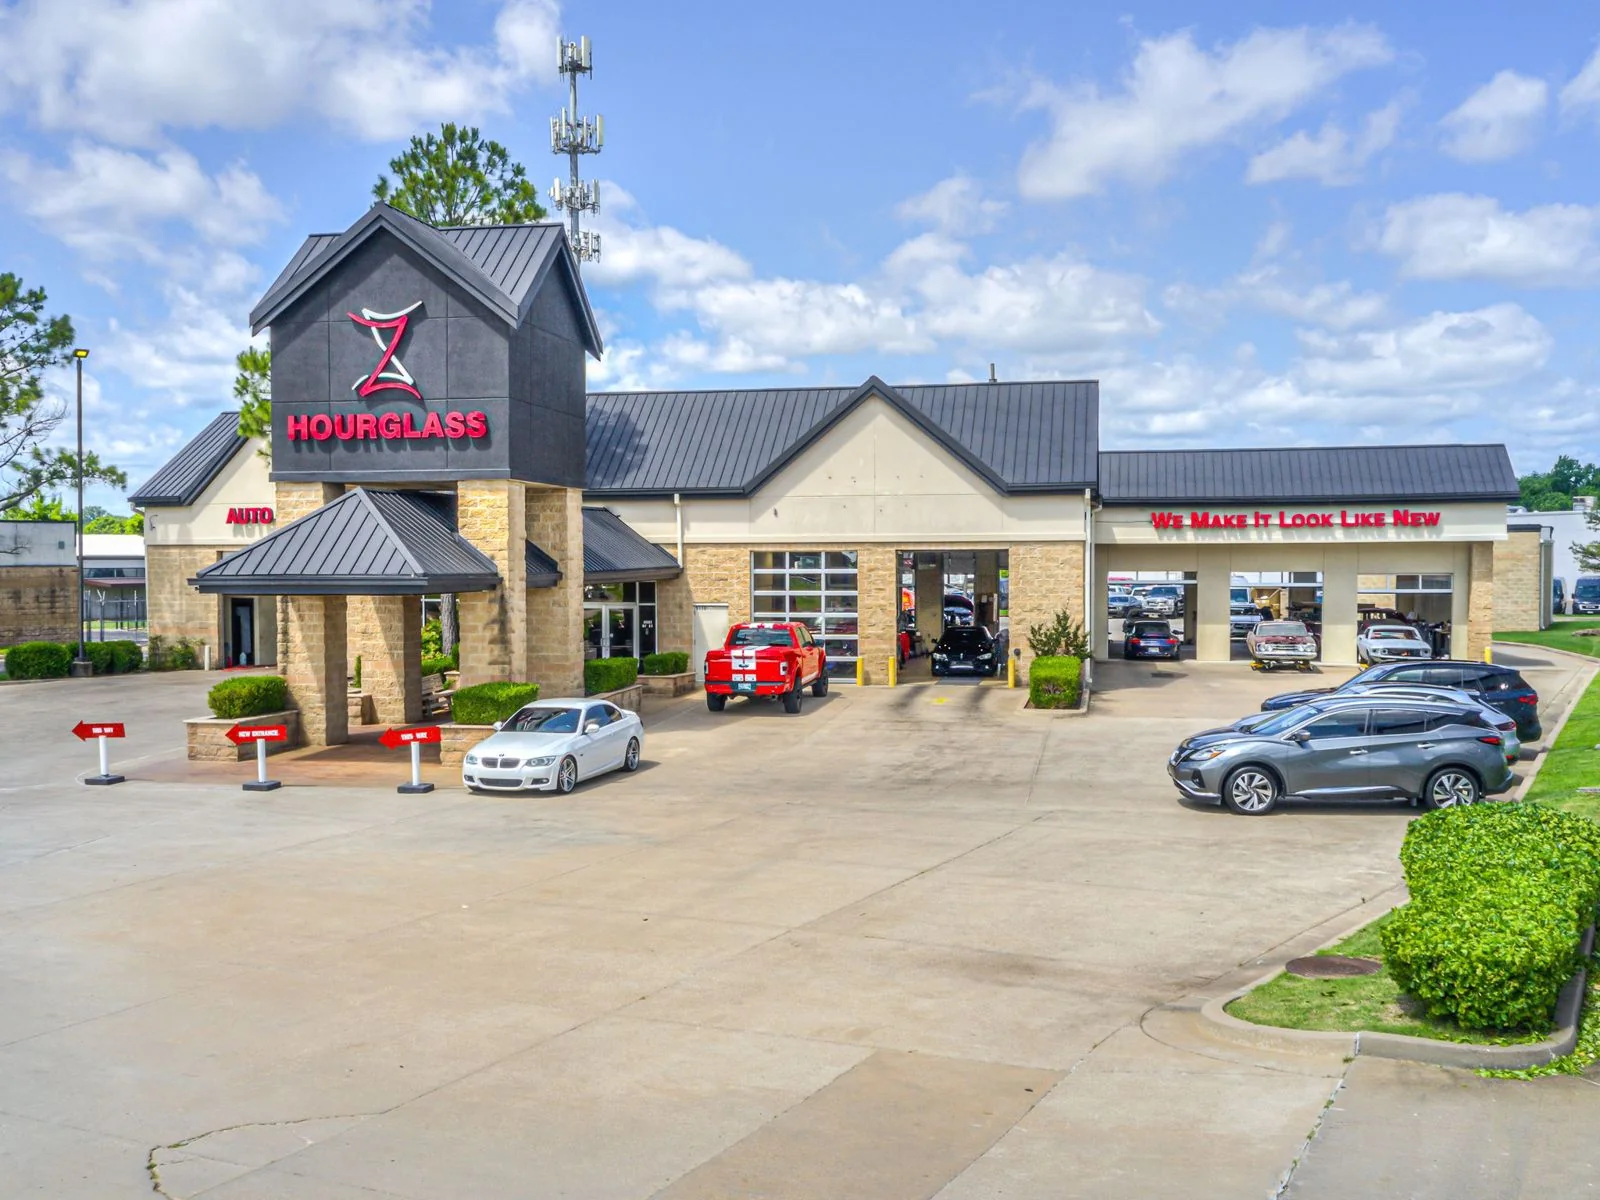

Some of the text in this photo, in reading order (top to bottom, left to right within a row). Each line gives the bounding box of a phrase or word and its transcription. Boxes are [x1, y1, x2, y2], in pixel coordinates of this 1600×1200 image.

[287, 410, 487, 441] HOURGLASS
[225, 507, 274, 525] AUTO
[238, 730, 251, 738] NEW
